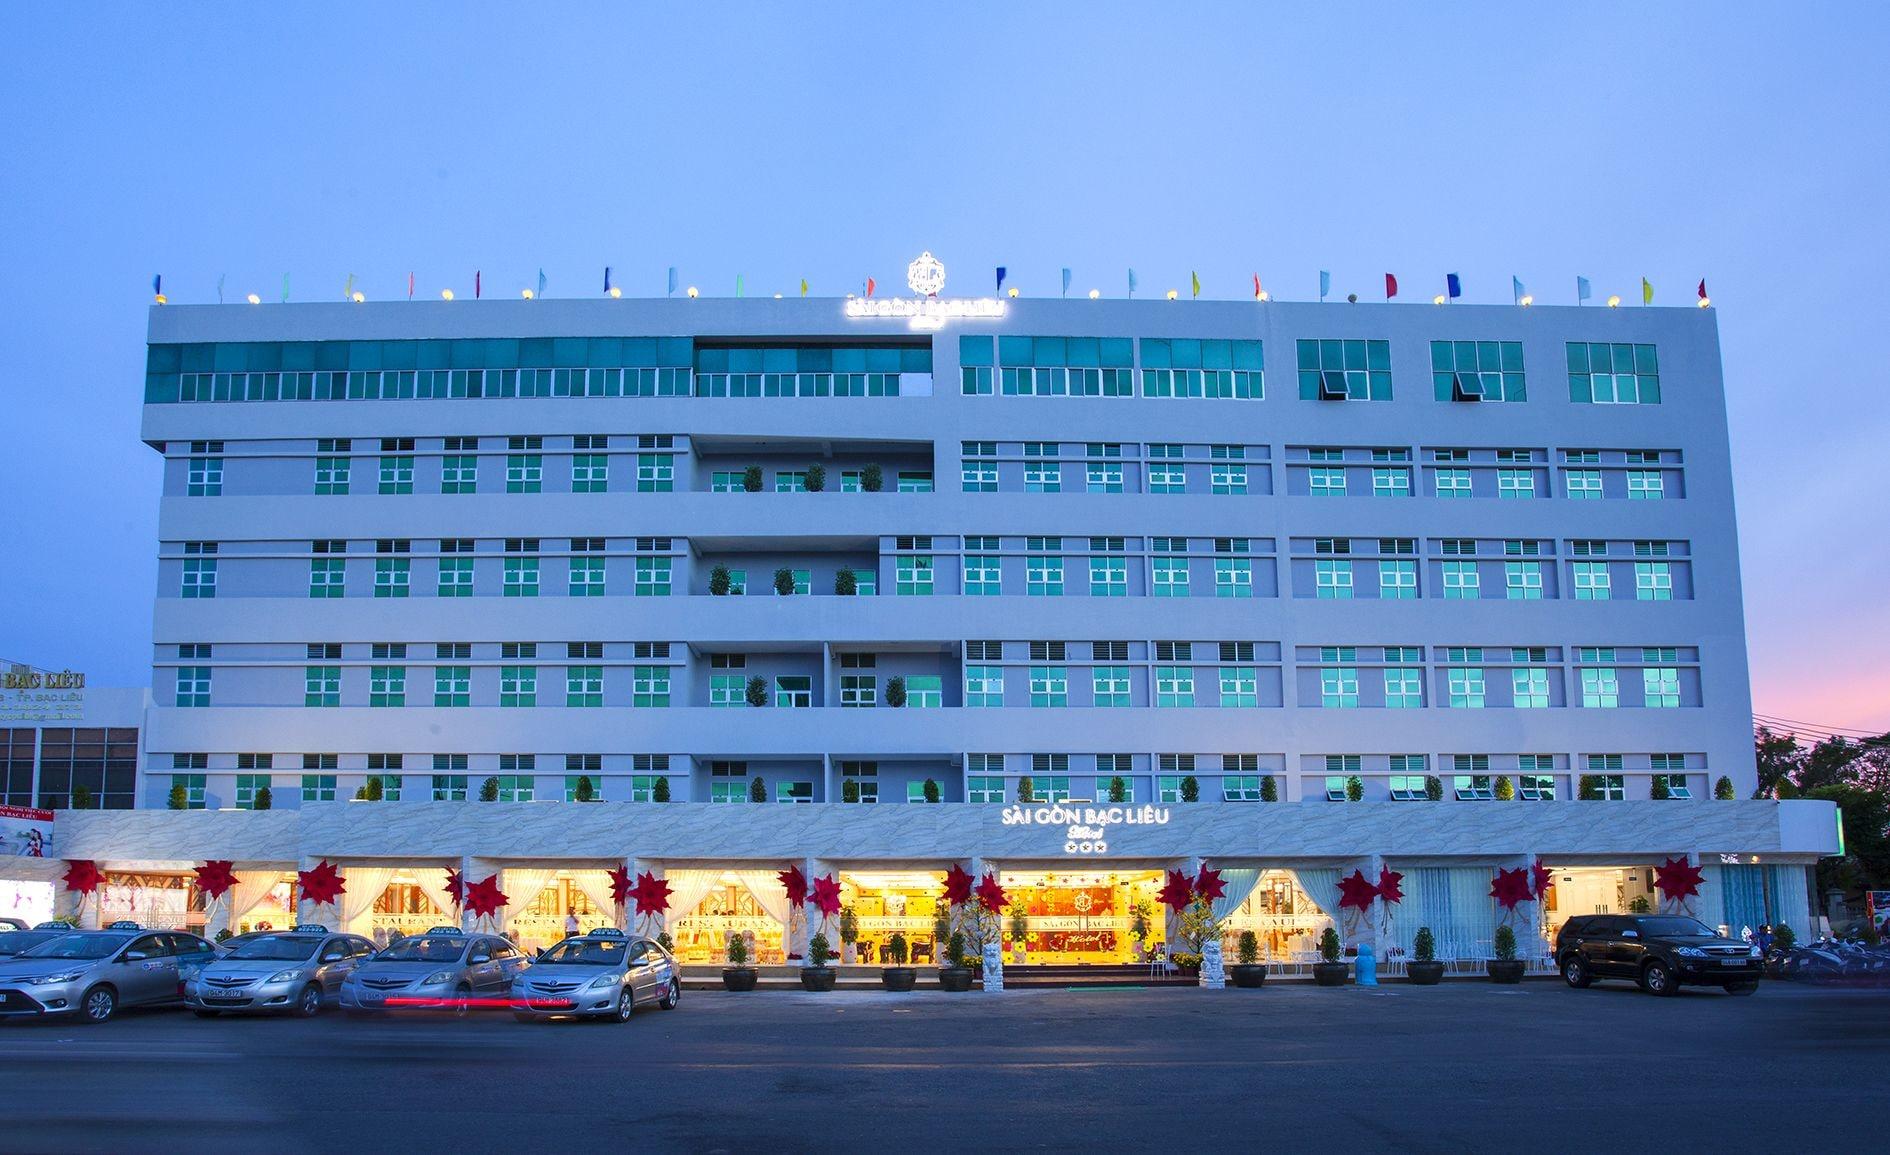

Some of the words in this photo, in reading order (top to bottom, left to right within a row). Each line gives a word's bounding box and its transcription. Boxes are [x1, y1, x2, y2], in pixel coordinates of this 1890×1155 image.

[1001, 804, 1031, 825] SÀI
[1034, 804, 1081, 825] GÒN
[1084, 807, 1123, 827] BẠC
[1126, 804, 1170, 825] LIÊU
